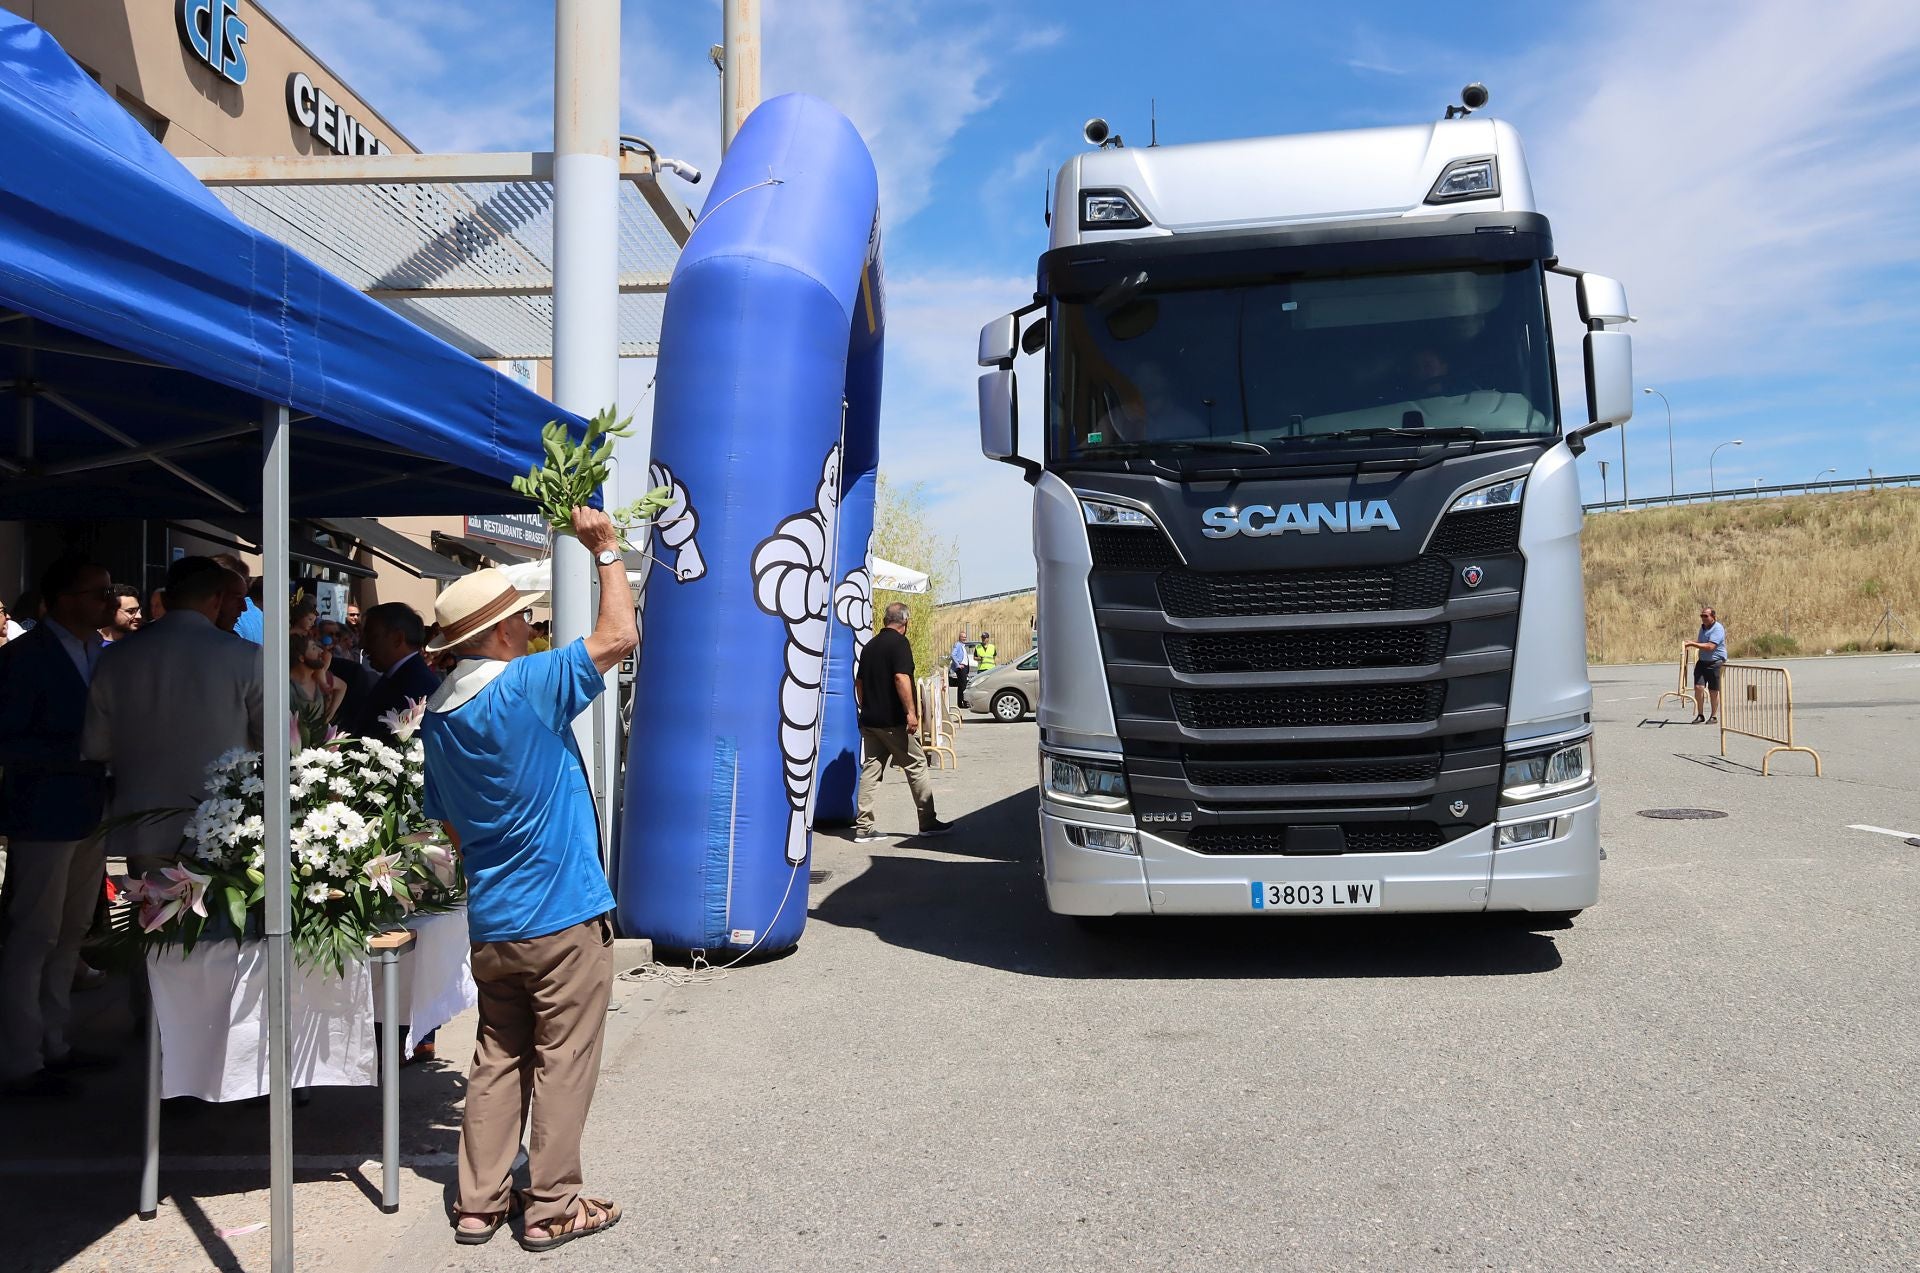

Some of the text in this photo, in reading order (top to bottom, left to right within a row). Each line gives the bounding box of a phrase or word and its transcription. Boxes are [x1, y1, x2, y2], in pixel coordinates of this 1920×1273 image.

[483, 520, 523, 540] RESTAURANTE
[1201, 499, 1401, 540] SCANIA
[1268, 885, 1324, 905] 3803
[1332, 884, 1373, 904] LWV
